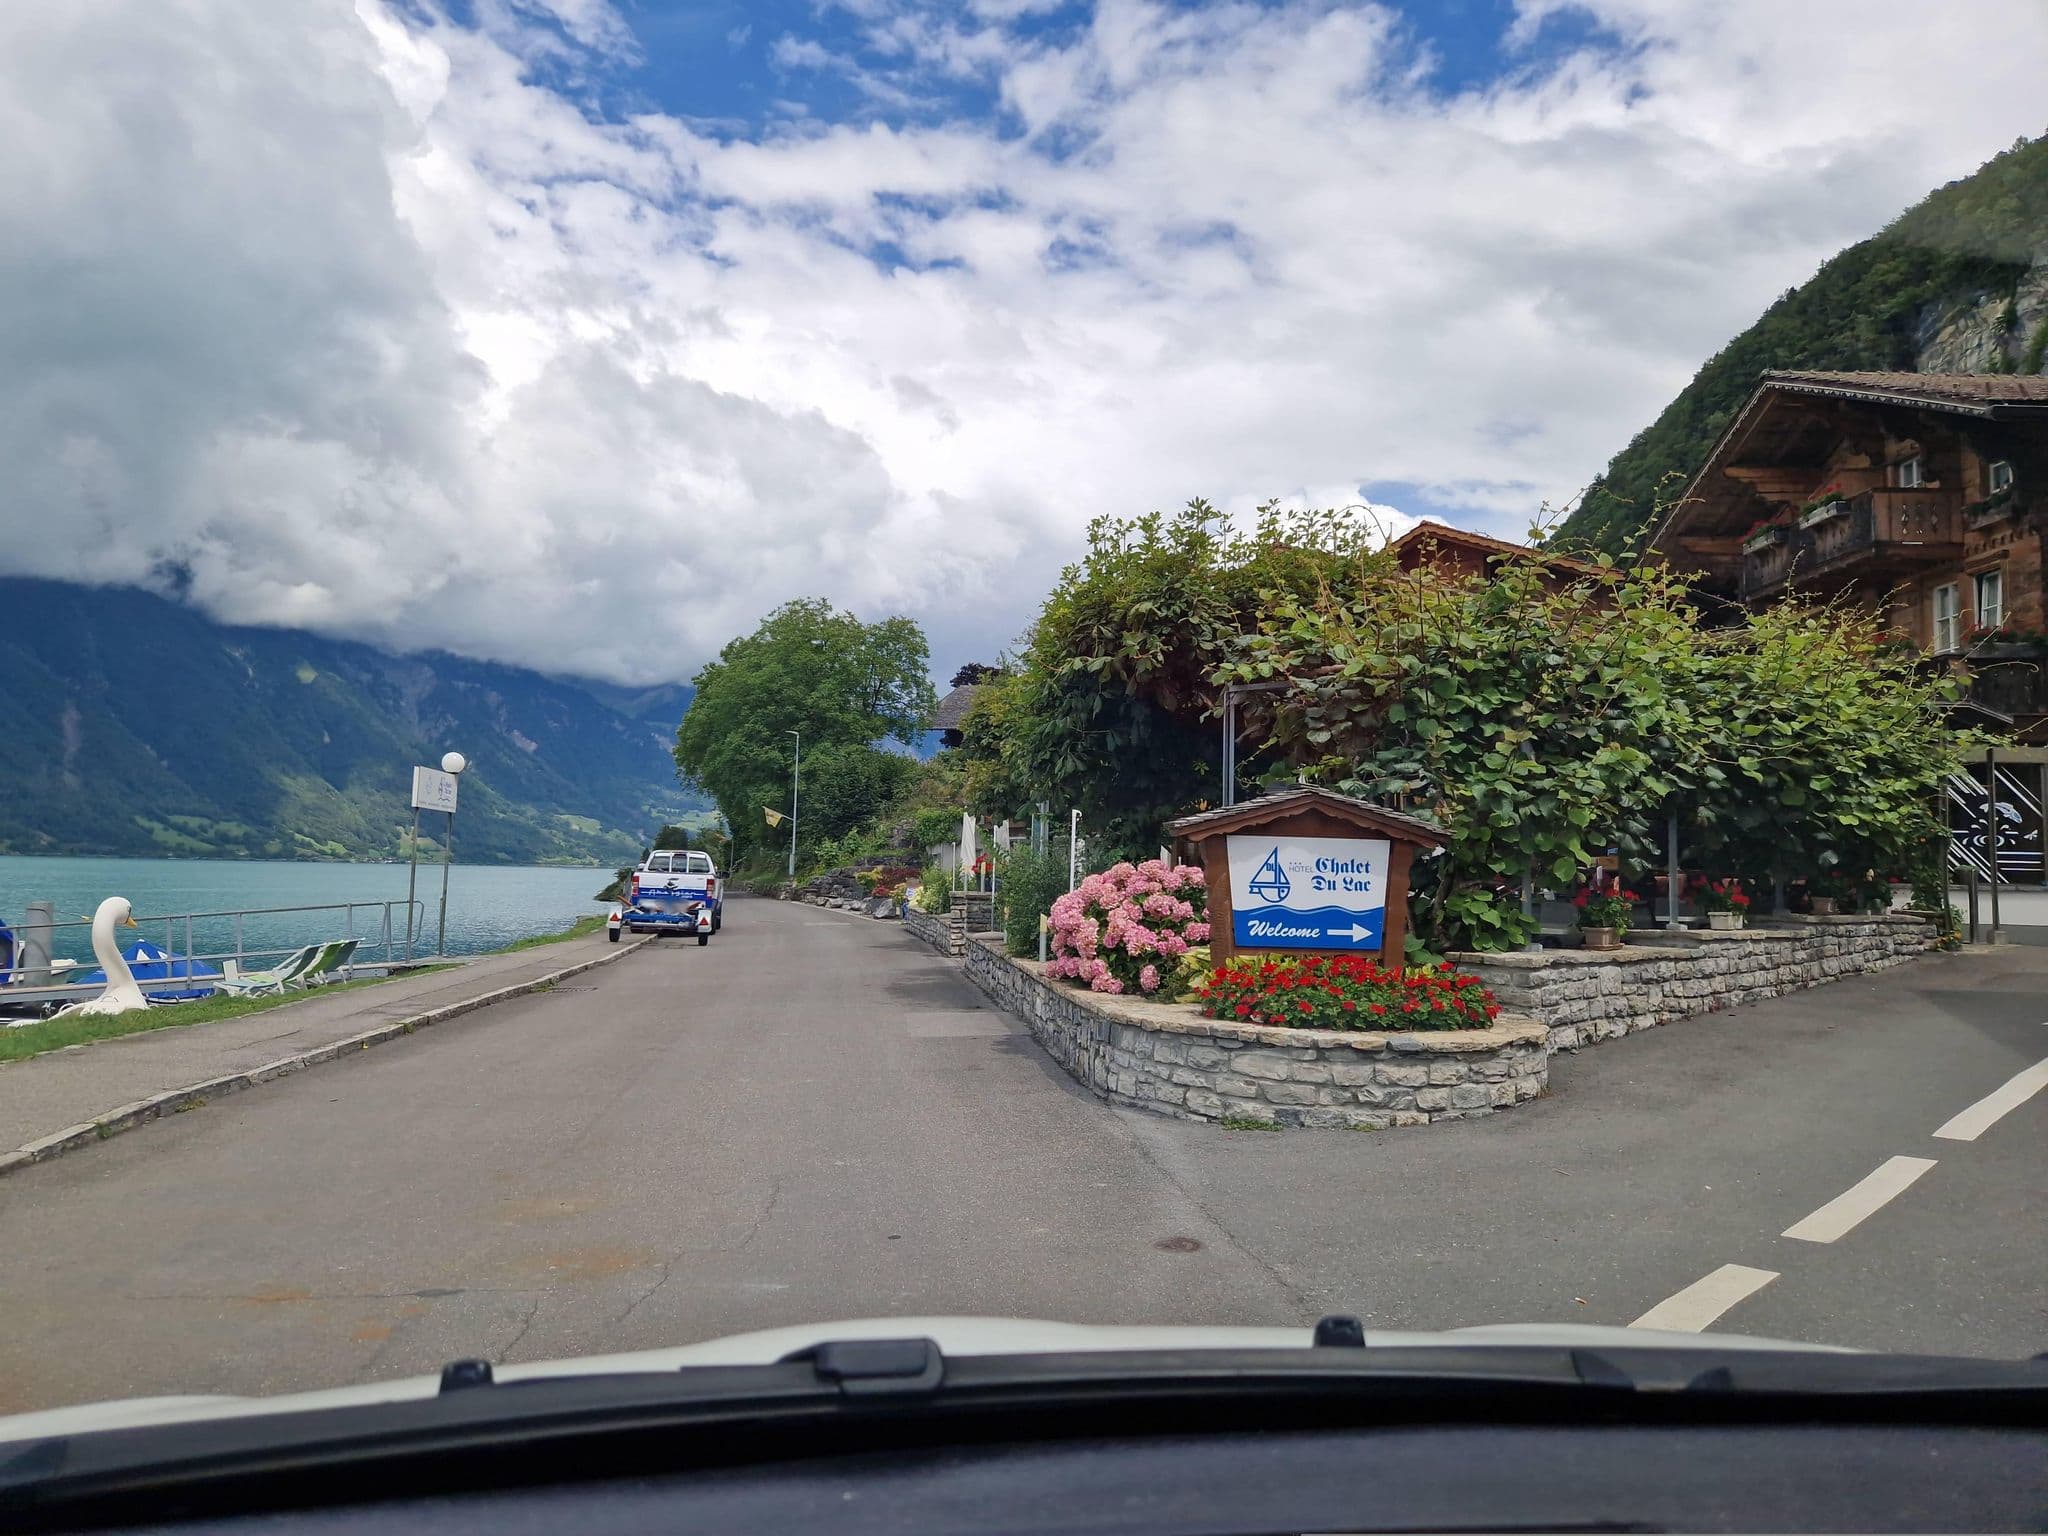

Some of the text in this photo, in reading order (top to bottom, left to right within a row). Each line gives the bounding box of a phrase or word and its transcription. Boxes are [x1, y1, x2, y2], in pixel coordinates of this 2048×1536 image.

[1315, 857, 1372, 876] Chalet
[1310, 875, 1372, 893] Du Lac
[1247, 919, 1321, 938] Welcome
